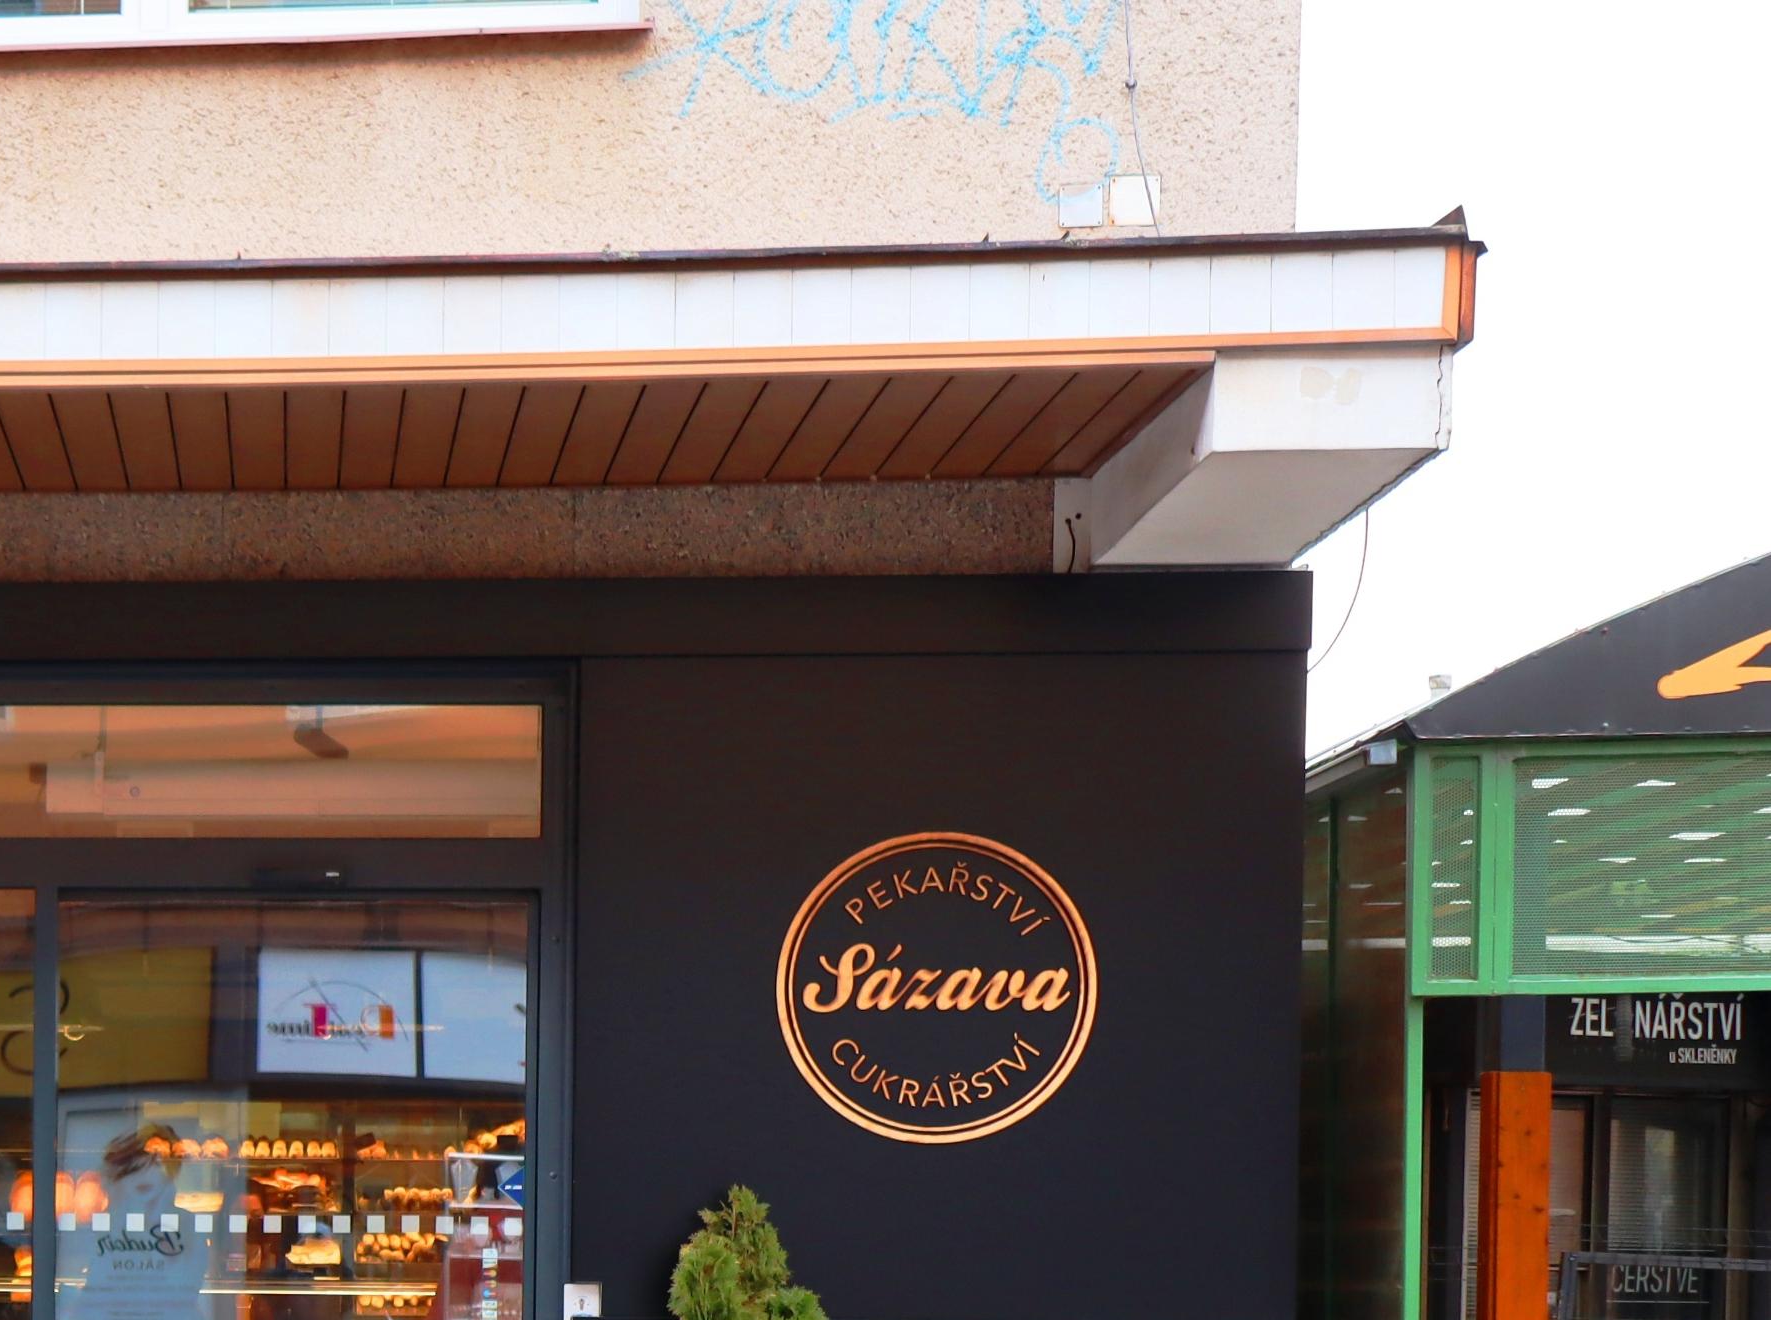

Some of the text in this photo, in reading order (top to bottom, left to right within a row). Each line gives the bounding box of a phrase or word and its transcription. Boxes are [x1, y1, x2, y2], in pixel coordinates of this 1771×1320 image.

[844, 861, 1050, 936] PEKAŘSTVÍ
[802, 943, 1071, 1013] Sázava
[1570, 993, 1744, 1041] ZELNÁŘSTVÍ
[831, 1032, 1041, 1108] CUKRÁŘSTVÍ
[1669, 1044, 1737, 1065] u SKLENĚNKY
